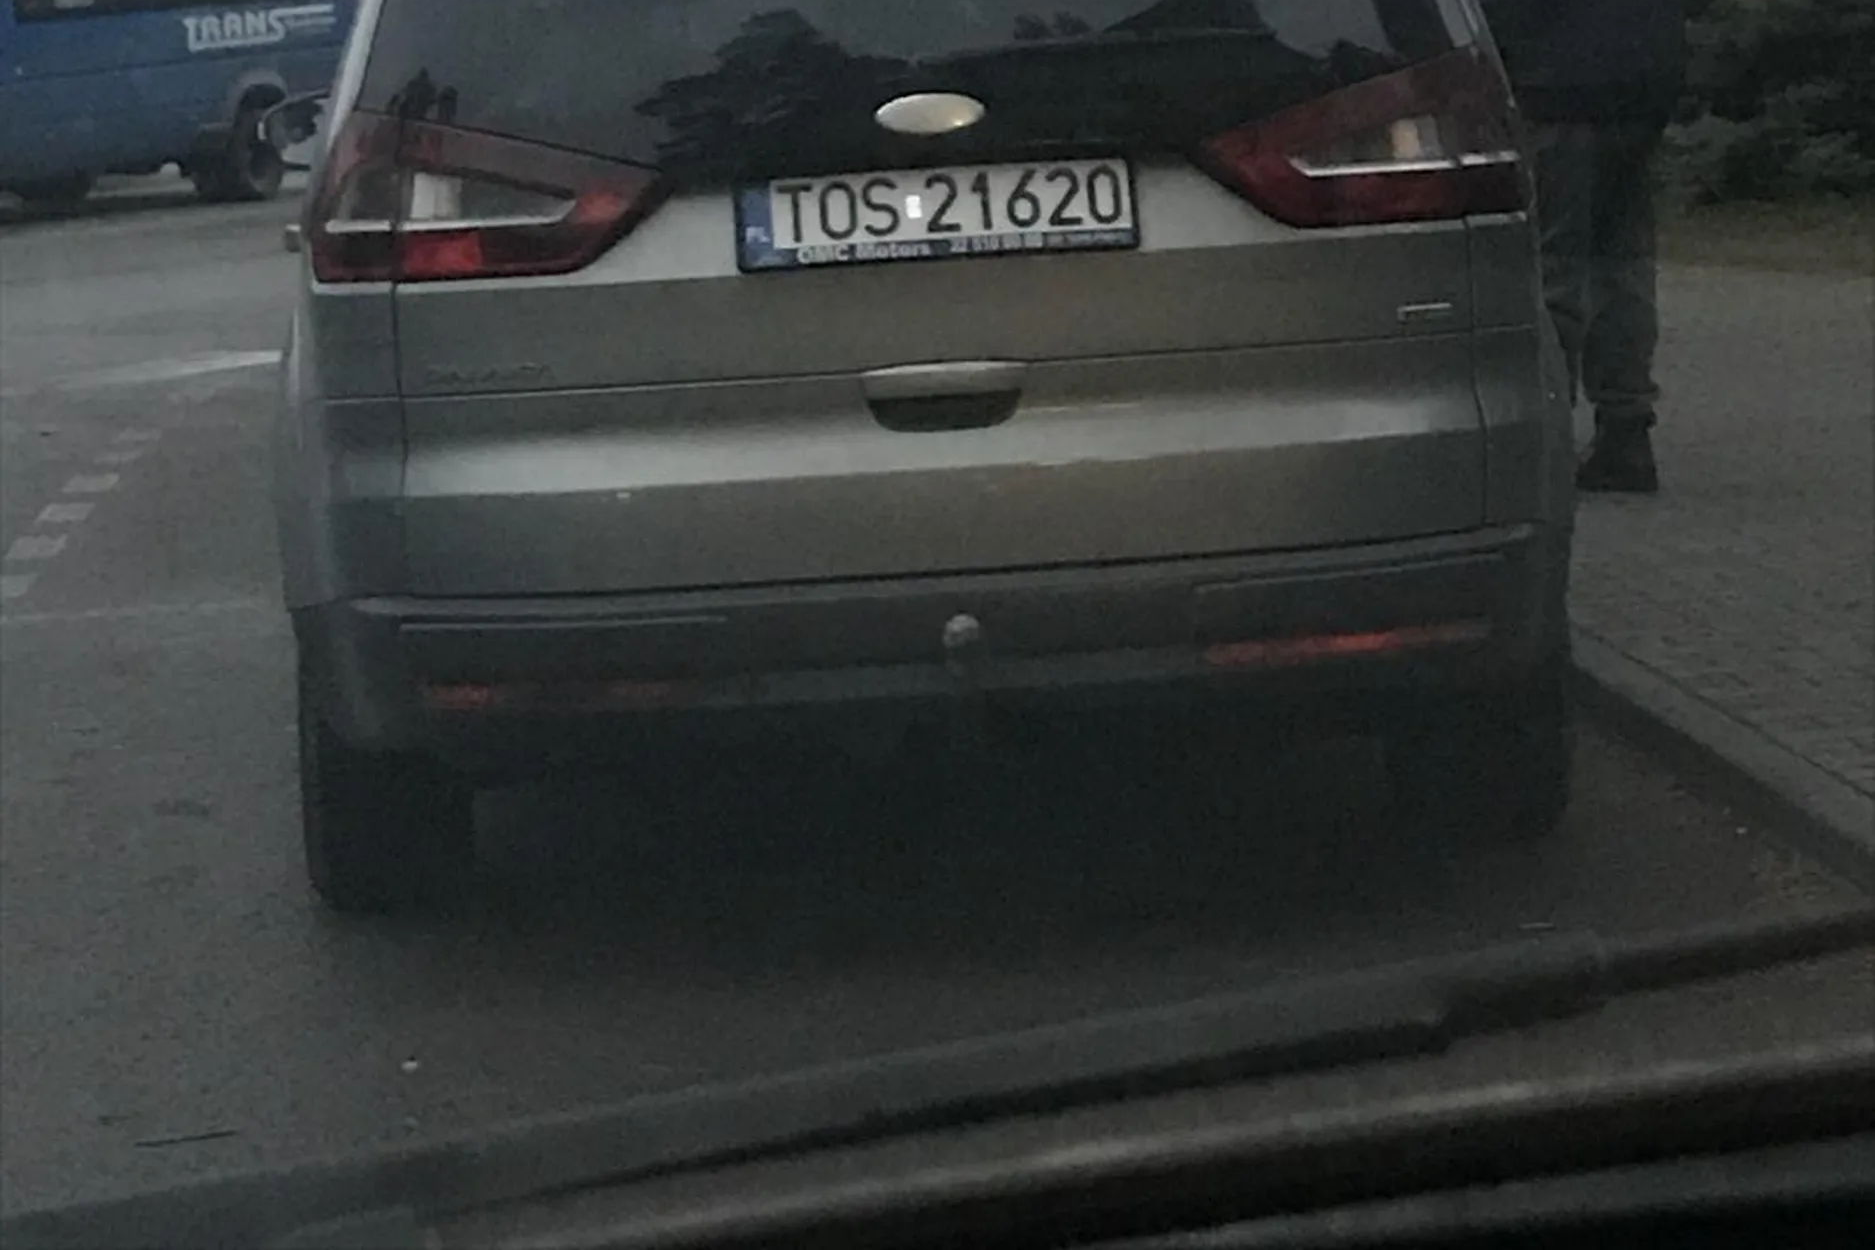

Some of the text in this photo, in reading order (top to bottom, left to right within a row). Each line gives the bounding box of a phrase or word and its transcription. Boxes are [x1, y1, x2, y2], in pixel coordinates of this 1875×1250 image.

[182, 4, 334, 53] TRANS
[777, 163, 1122, 243] TOS 21620
[855, 239, 932, 260] Motors
